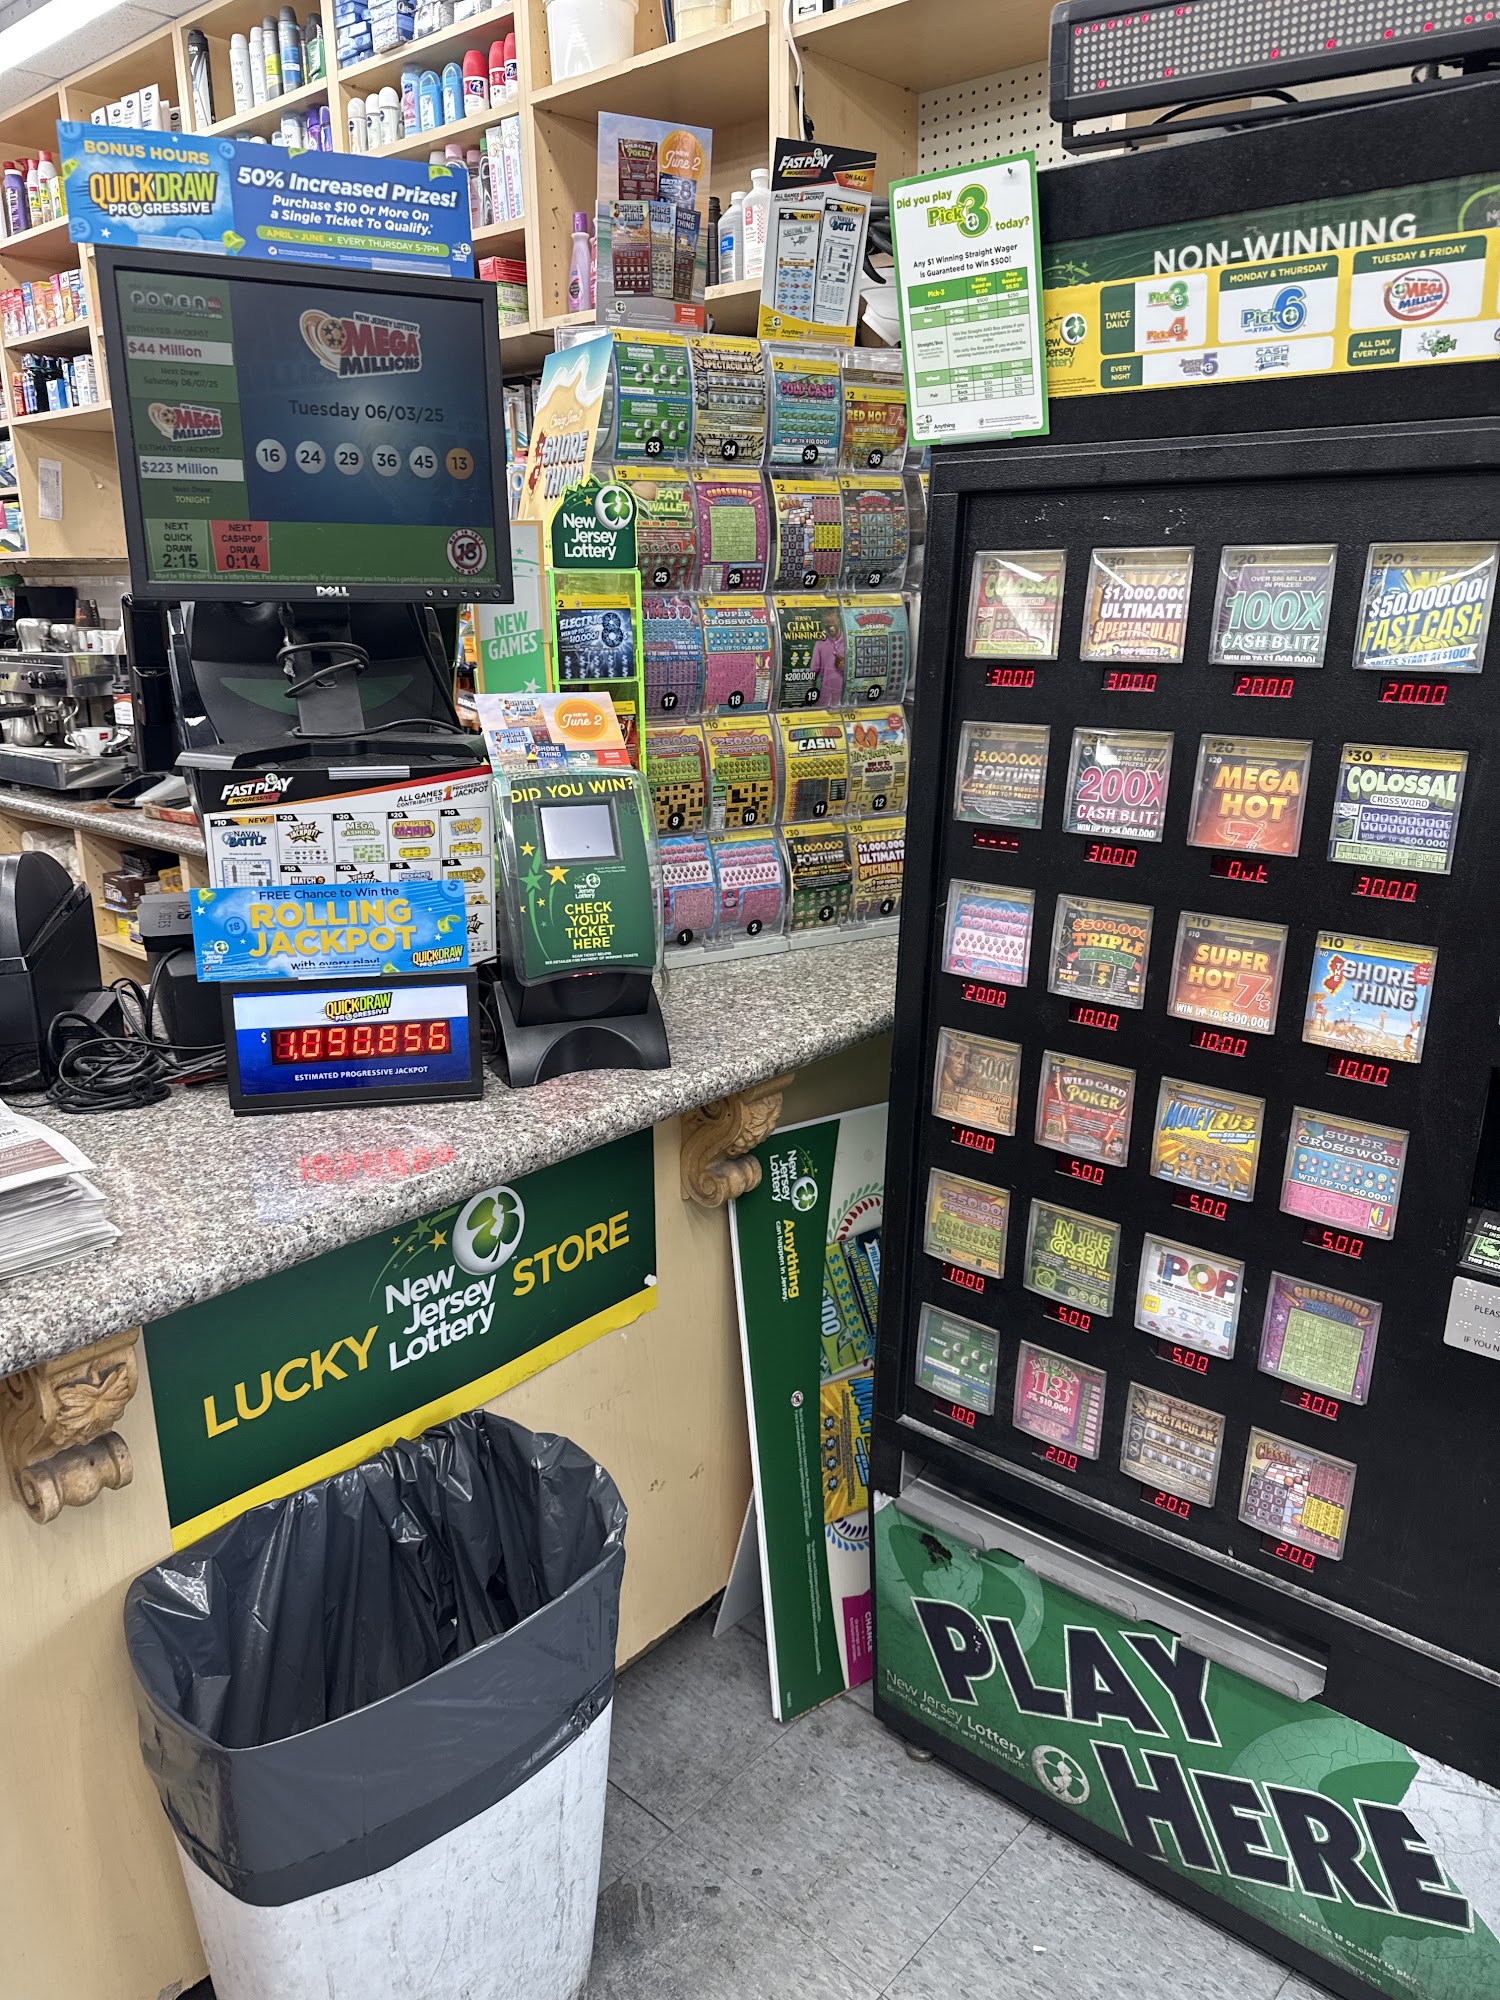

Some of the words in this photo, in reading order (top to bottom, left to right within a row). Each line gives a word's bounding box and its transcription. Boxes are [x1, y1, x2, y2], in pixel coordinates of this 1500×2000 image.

[83, 140, 146, 159] BONUS
[150, 146, 209, 165] HOURS
[663, 151, 690, 169] June
[692, 157, 701, 171] 2
[779, 156, 804, 171] FAST
[804, 153, 834, 169] PLAY
[89, 171, 217, 205] QUICKDRAW
[236, 166, 286, 189] 50%
[288, 173, 389, 200] Increased
[391, 185, 459, 208] Prizes!
[272, 194, 331, 213] Purchase
[334, 200, 359, 214] $10
[361, 203, 377, 216] Or
[379, 205, 409, 219] More
[412, 208, 430, 220] On
[896, 199, 911, 209] Did
[913, 197, 930, 206] you
[933, 190, 953, 203] play
[927, 206, 964, 227] Pick
[957, 184, 991, 237] 3
[281, 208, 321, 226] Single
[323, 214, 364, 229] Ticket
[367, 217, 383, 230] To
[995, 216, 1030, 231] today?
[338, 235, 366, 246] EVERY
[367, 238, 414, 251] THURSDAY
[1153, 213, 1418, 276] NON-WINNING
[913, 260, 926, 269] Any
[927, 258, 935, 266] $1
[936, 253, 963, 265] Winning
[965, 248, 993, 260] Straight
[994, 244, 1018, 255] Wager
[1372, 252, 1416, 266] TUESDAY
[1429, 244, 1467, 257] FRIDAY
[926, 263, 965, 277] Guaranteed
[975, 260, 989, 269] Win
[991, 256, 1012, 267] $500!
[1229, 271, 1269, 283] MONDAY
[1279, 262, 1328, 277] THURSDAY
[1104, 310, 1131, 321] TWICE
[1241, 310, 1280, 328] Pick
[1273, 287, 1306, 332] 6
[1106, 319, 1130, 330] DAILY
[344, 323, 421, 358] MEGA
[338, 354, 422, 376] MILLIONS
[780, 382, 805, 396] COLD
[807, 386, 835, 397] CASH
[288, 401, 359, 421] Tuesday
[364, 404, 445, 424] 06/03/25
[847, 410, 867, 422] RED
[870, 410, 888, 422] HOT
[262, 449, 281, 463] 16
[300, 450, 322, 464] 24
[647, 440, 661, 454] 33
[722, 443, 738, 456] 34
[803, 448, 816, 462] 35
[141, 459, 173, 474] $223
[176, 462, 218, 476] Million
[339, 451, 360, 466] 29
[377, 453, 398, 468] 36
[414, 455, 434, 470] 45
[452, 457, 468, 471] 13
[868, 453, 882, 466] 36
[656, 487, 684, 500] FAT
[649, 502, 689, 515] WALLET
[164, 522, 189, 531] NEXT
[228, 523, 253, 533] NEXT
[563, 513, 595, 528] New
[163, 533, 193, 543] QUICK
[221, 535, 263, 544] CASHPOP
[570, 529, 617, 546] Jersey
[162, 554, 199, 569] 2:15
[226, 554, 260, 570] 0:14
[563, 544, 617, 561] Lottery
[316, 586, 349, 598] DELL
[1226, 590, 1324, 630] 100X
[494, 612, 527, 635] NEW
[786, 620, 821, 633] GIANT
[783, 631, 826, 641] WINNINGS
[1221, 633, 1266, 648] CASH
[1272, 636, 1320, 650] BLITZ
[488, 636, 538, 660] GAMES
[1108, 674, 1157, 690] 30.00
[1236, 677, 1294, 697] 20.00
[562, 714, 590, 727] June
[594, 715, 602, 726] 2
[220, 784, 255, 800] FAST
[254, 777, 294, 796] PLAY
[510, 787, 541, 803] DID
[546, 783, 584, 799] YOU
[588, 777, 633, 795] WIN?
[1214, 765, 1300, 794] MEGA
[1347, 766, 1456, 803] COLOSSAL
[1219, 794, 1289, 821] HOT
[1371, 796, 1428, 808] CROSSWORD
[259, 890, 290, 901] FREE
[294, 888, 336, 900] Chance
[340, 888, 352, 898] to
[356, 887, 379, 898] Win
[381, 886, 399, 897] the
[1357, 877, 1417, 901] 30.00
[251, 900, 411, 928] ROLLING
[564, 901, 613, 915] CHECK
[565, 925, 616, 938] TICKET
[570, 915, 610, 926] YOUR
[249, 926, 417, 958] JACKPOT
[573, 938, 611, 950] HERE
[1194, 944, 1270, 972] SUPER
[1188, 965, 1236, 990] HOT
[1342, 961, 1416, 991] SHORE
[1351, 982, 1415, 1010] THING
[287, 1022, 447, 1060] 1,090,856
[294, 1072, 339, 1081] ESTIMATED
[341, 1068, 393, 1079] PROGRESSIVE
[395, 1065, 428, 1075] JACKPOT
[1336, 1058, 1389, 1085] 10.00
[1063, 1075, 1092, 1088] WILD
[1096, 1081, 1127, 1098] CARD
[1068, 1085, 1120, 1110] POKER
[787, 1150, 797, 1180] New
[1072, 1162, 1105, 1183] 5.00
[769, 1154, 782, 1203] Lottery
[779, 1159, 790, 1201] Jersey
[1054, 1218, 1074, 1237] IN
[1078, 1226, 1111, 1248] THE
[513, 1210, 630, 1296] STORE
[783, 1219, 799, 1298] Anything
[1050, 1238, 1107, 1268] GREEN
[384, 1265, 456, 1314] New
[949, 1268, 985, 1292] 10.00
[402, 1274, 497, 1336] Jersey
[388, 1300, 496, 1372] Lottery
[1172, 1347, 1209, 1372] 5.00
[203, 1325, 379, 1439] LUCKY
[1300, 1391, 1339, 1417] 3.00
[1045, 1446, 1078, 1470] 2.00
[1275, 1542, 1316, 1570] 2.00
[912, 1597, 1222, 1748] PLAY
[885, 1669, 918, 1695] New
[921, 1690, 963, 1724] Jersey
[967, 1713, 1027, 1759] Lottery
[1092, 1740, 1475, 1934] HERE
[1299, 1912, 1319, 1929] Must
[1321, 1924, 1333, 1936] be
[1334, 1931, 1344, 1942] 18
[1346, 1938, 1356, 1949] or
[1358, 1945, 1383, 1965] older
[1384, 1959, 1396, 1971] to
